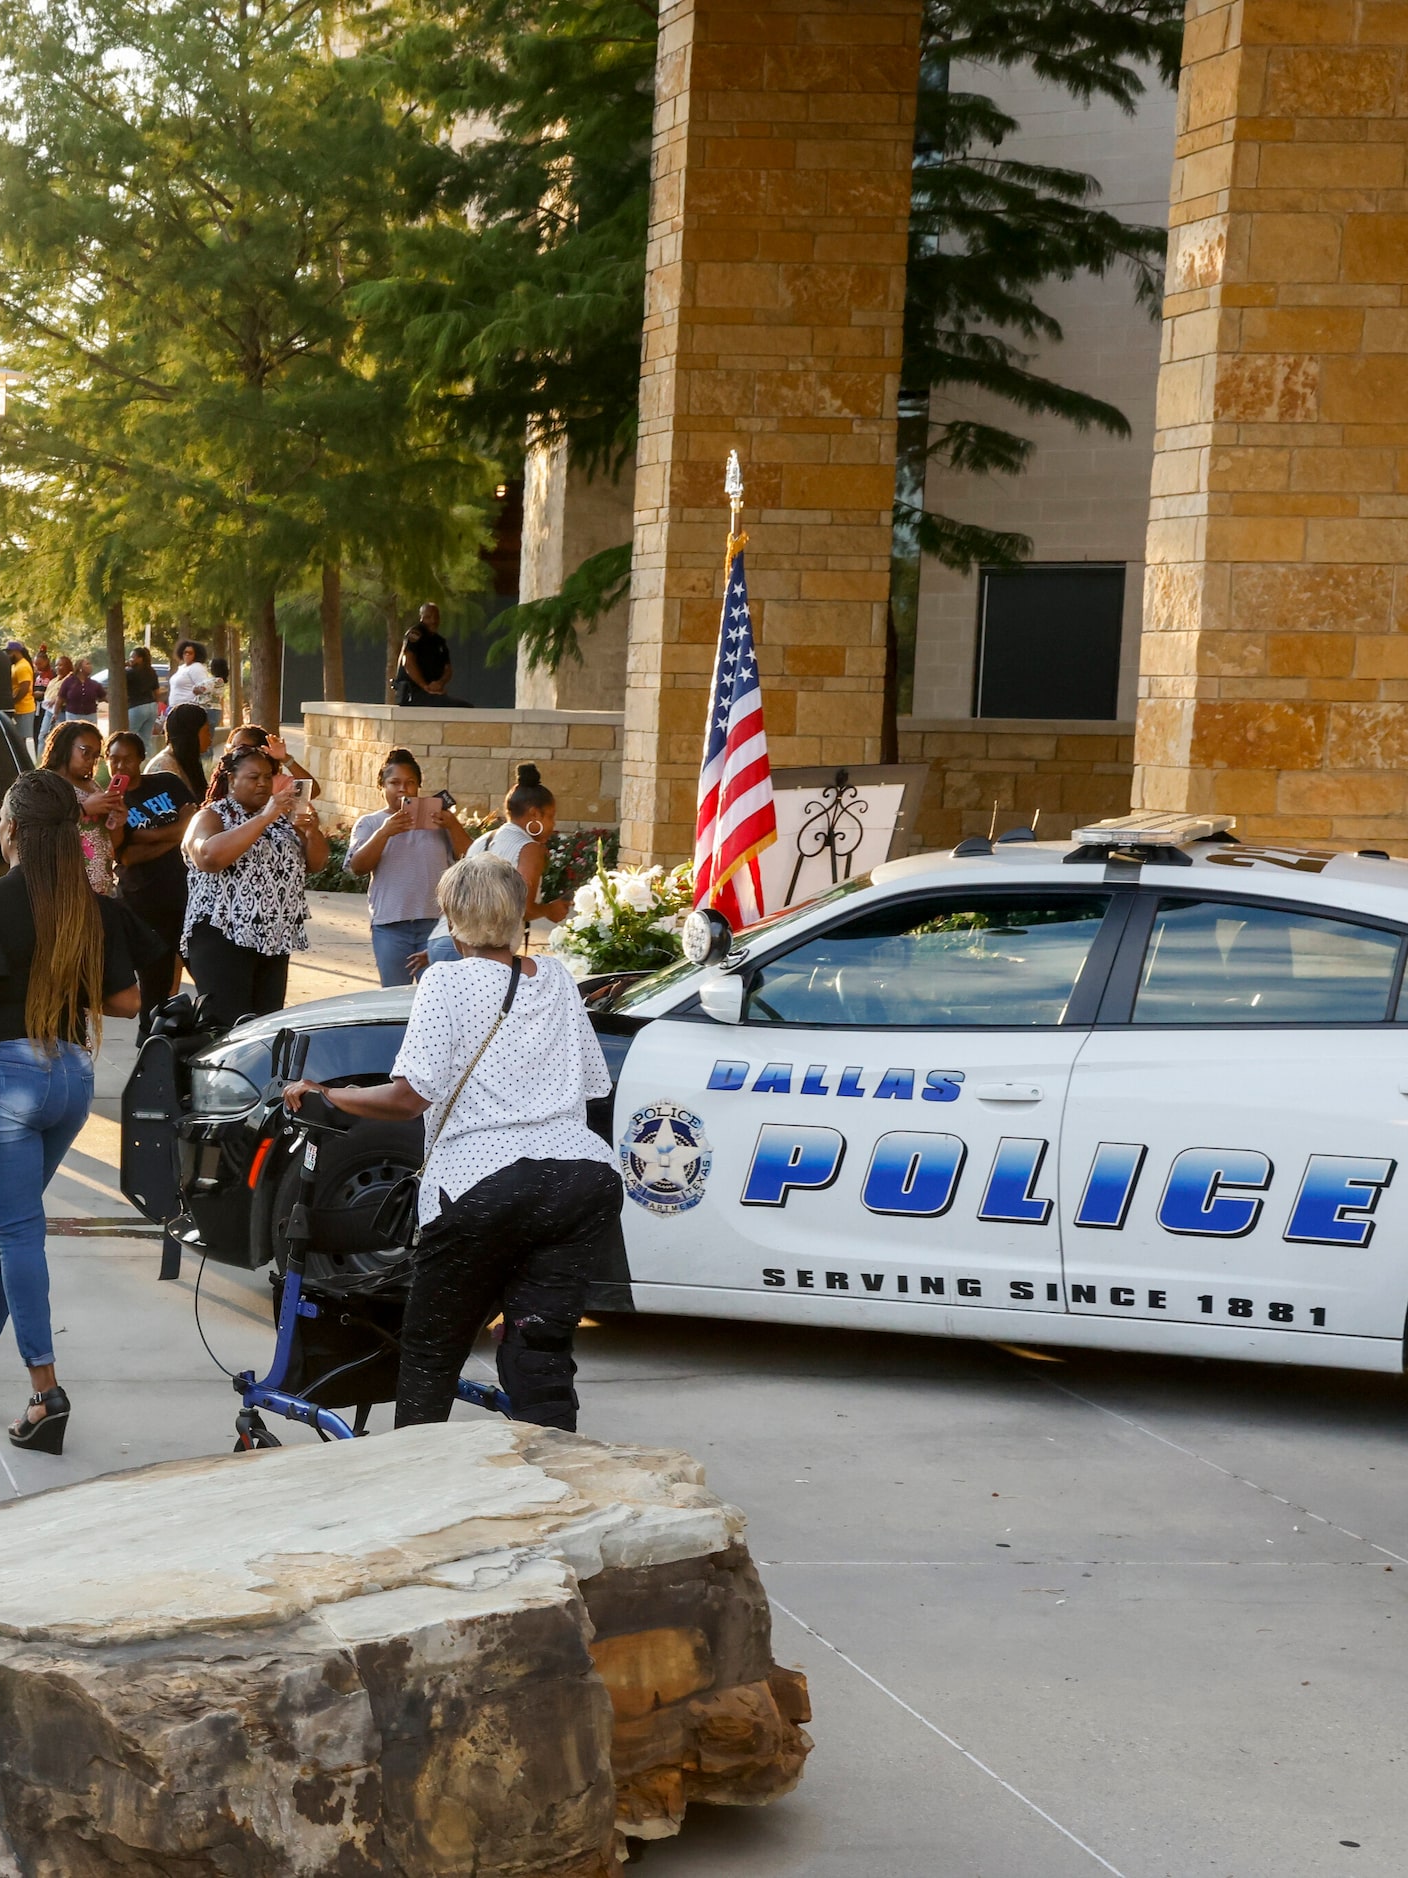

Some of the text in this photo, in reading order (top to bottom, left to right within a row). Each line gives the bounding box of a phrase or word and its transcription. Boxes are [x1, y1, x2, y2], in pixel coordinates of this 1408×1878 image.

[127, 792, 177, 828] BEIEVE
[706, 1060, 966, 1102] DALLAS
[632, 1107, 701, 1129] POLICE
[621, 1151, 642, 1191] DALLAS
[686, 1160, 710, 1195] TEXAS
[741, 1123, 1398, 1248] POLICE
[631, 1191, 699, 1211] DEPARTMENT
[763, 1267, 1327, 1327] SERVING SINCE 1881
